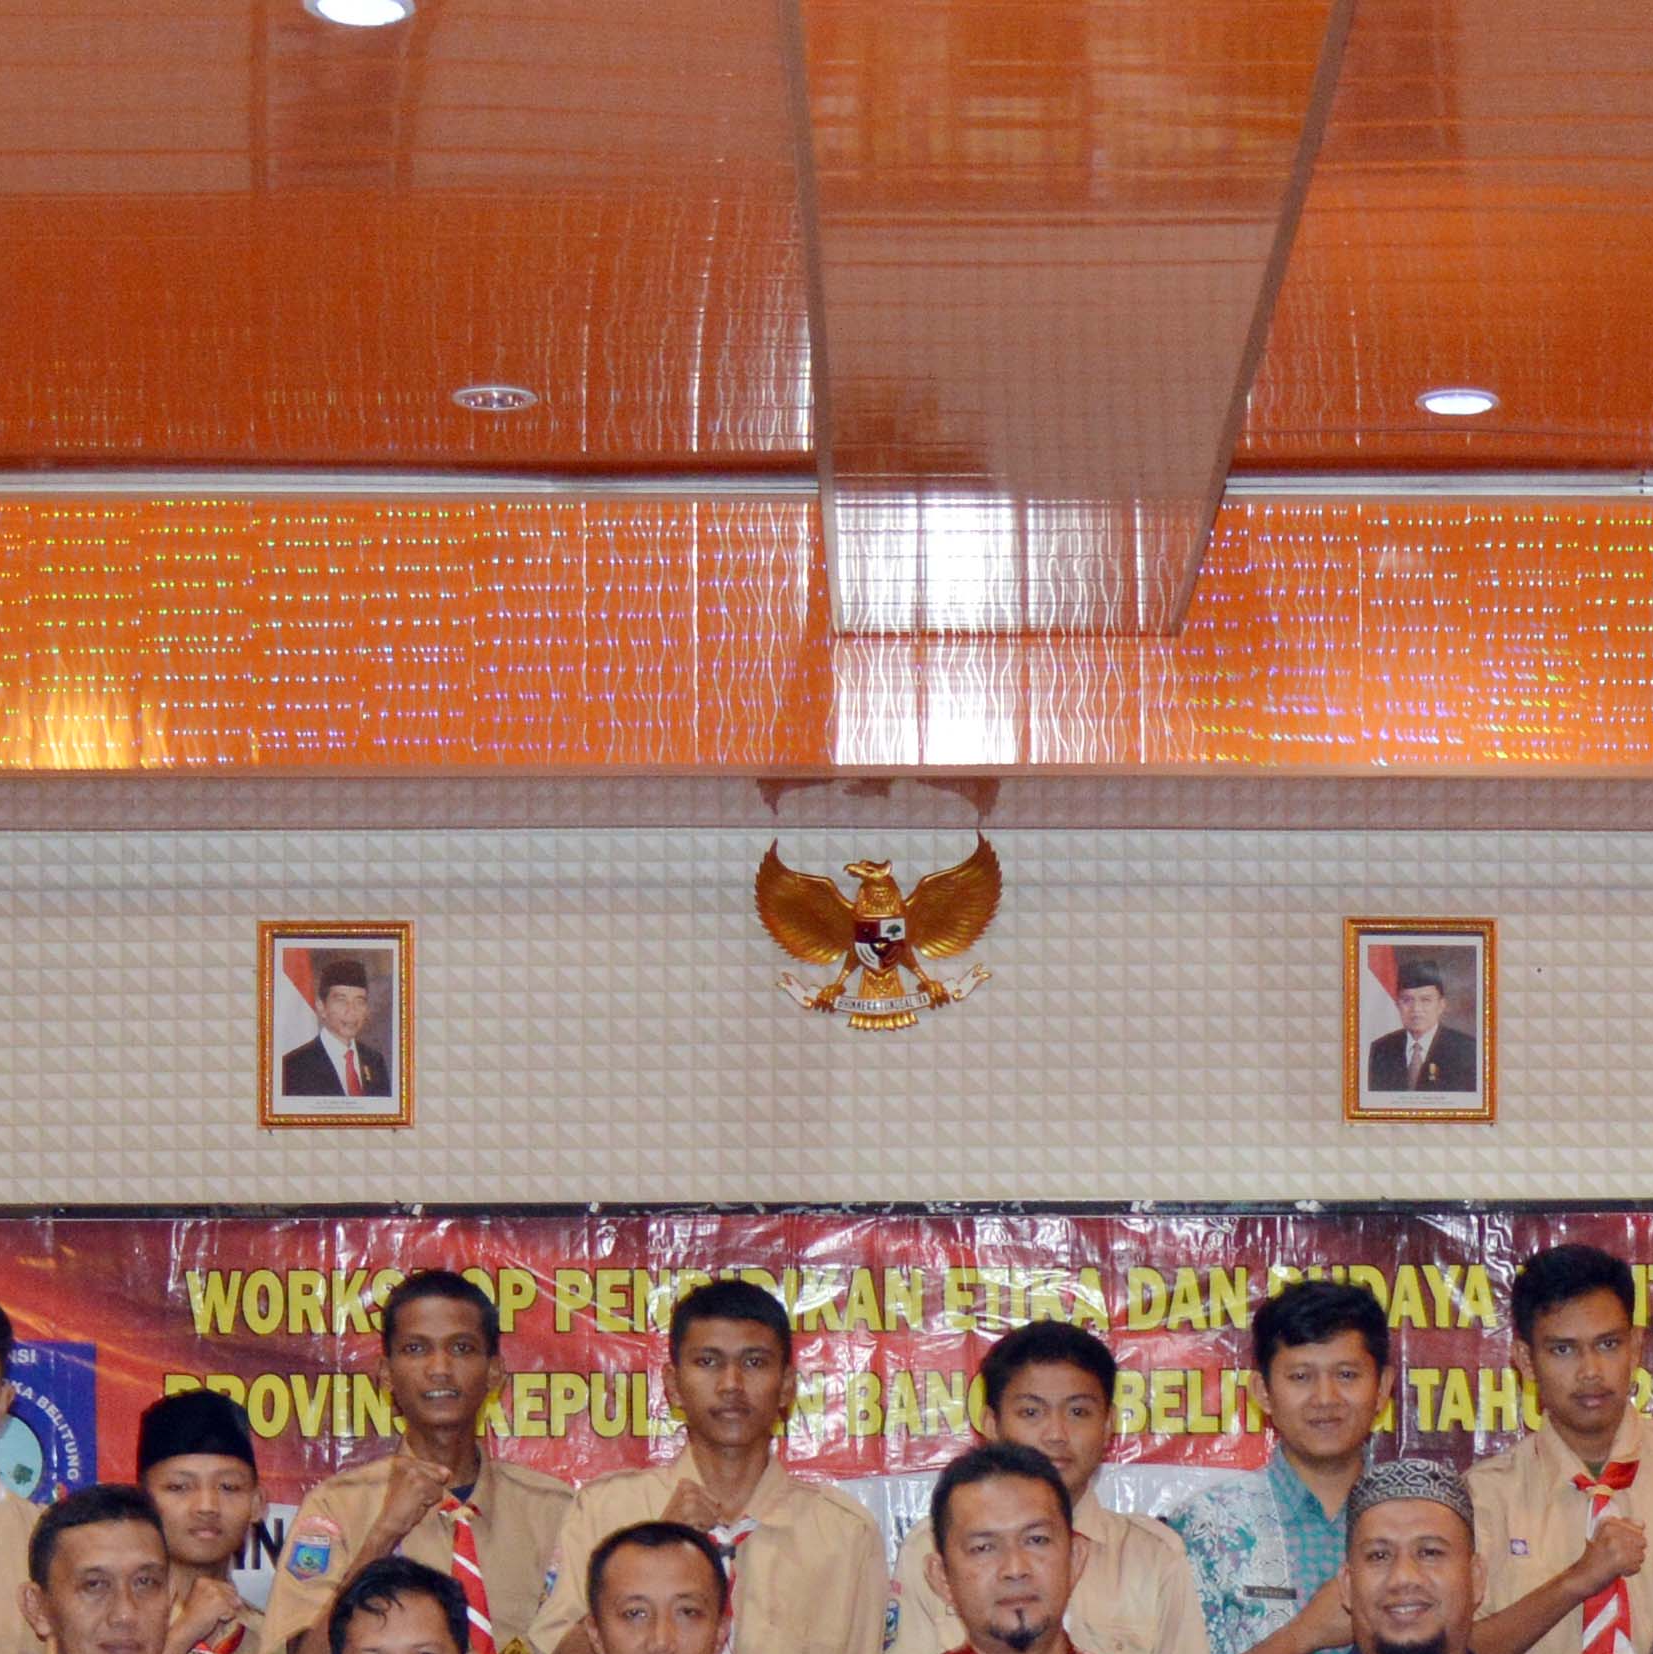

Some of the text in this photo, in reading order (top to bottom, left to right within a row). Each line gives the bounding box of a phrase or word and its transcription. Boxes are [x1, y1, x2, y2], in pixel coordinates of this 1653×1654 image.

[944, 1266, 1110, 1331] ETIKA
[1126, 1266, 1248, 1331] DAN
[36, 1395, 80, 1481] BELITUNG
